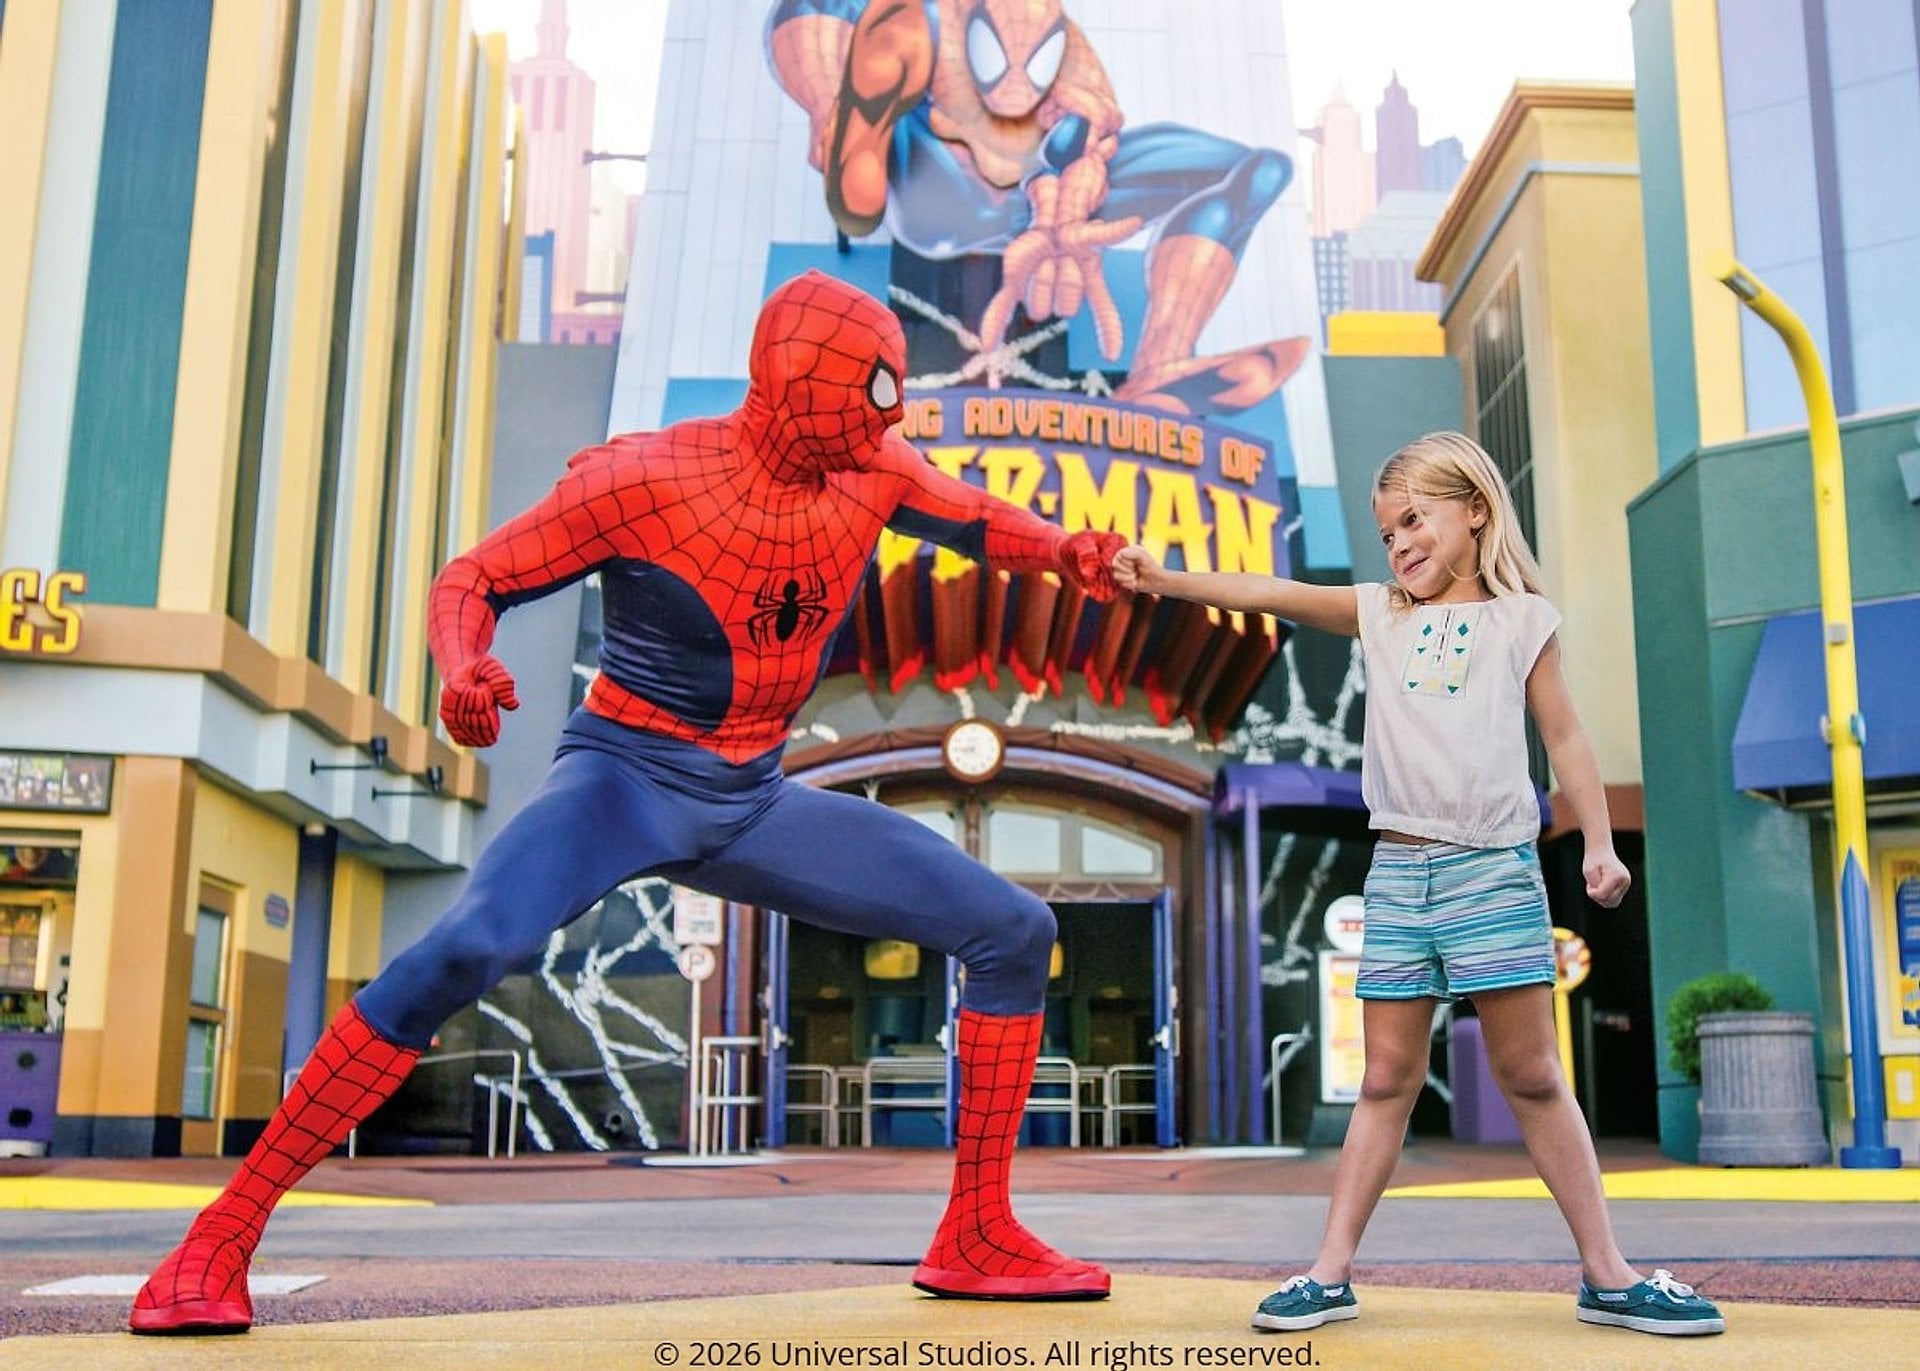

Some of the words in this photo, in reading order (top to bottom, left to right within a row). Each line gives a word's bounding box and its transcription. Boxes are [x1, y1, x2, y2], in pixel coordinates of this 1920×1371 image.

[963, 397, 1205, 467] ADVENTURES
[1220, 436, 1267, 485] OF
[0, 567, 85, 655] ES
